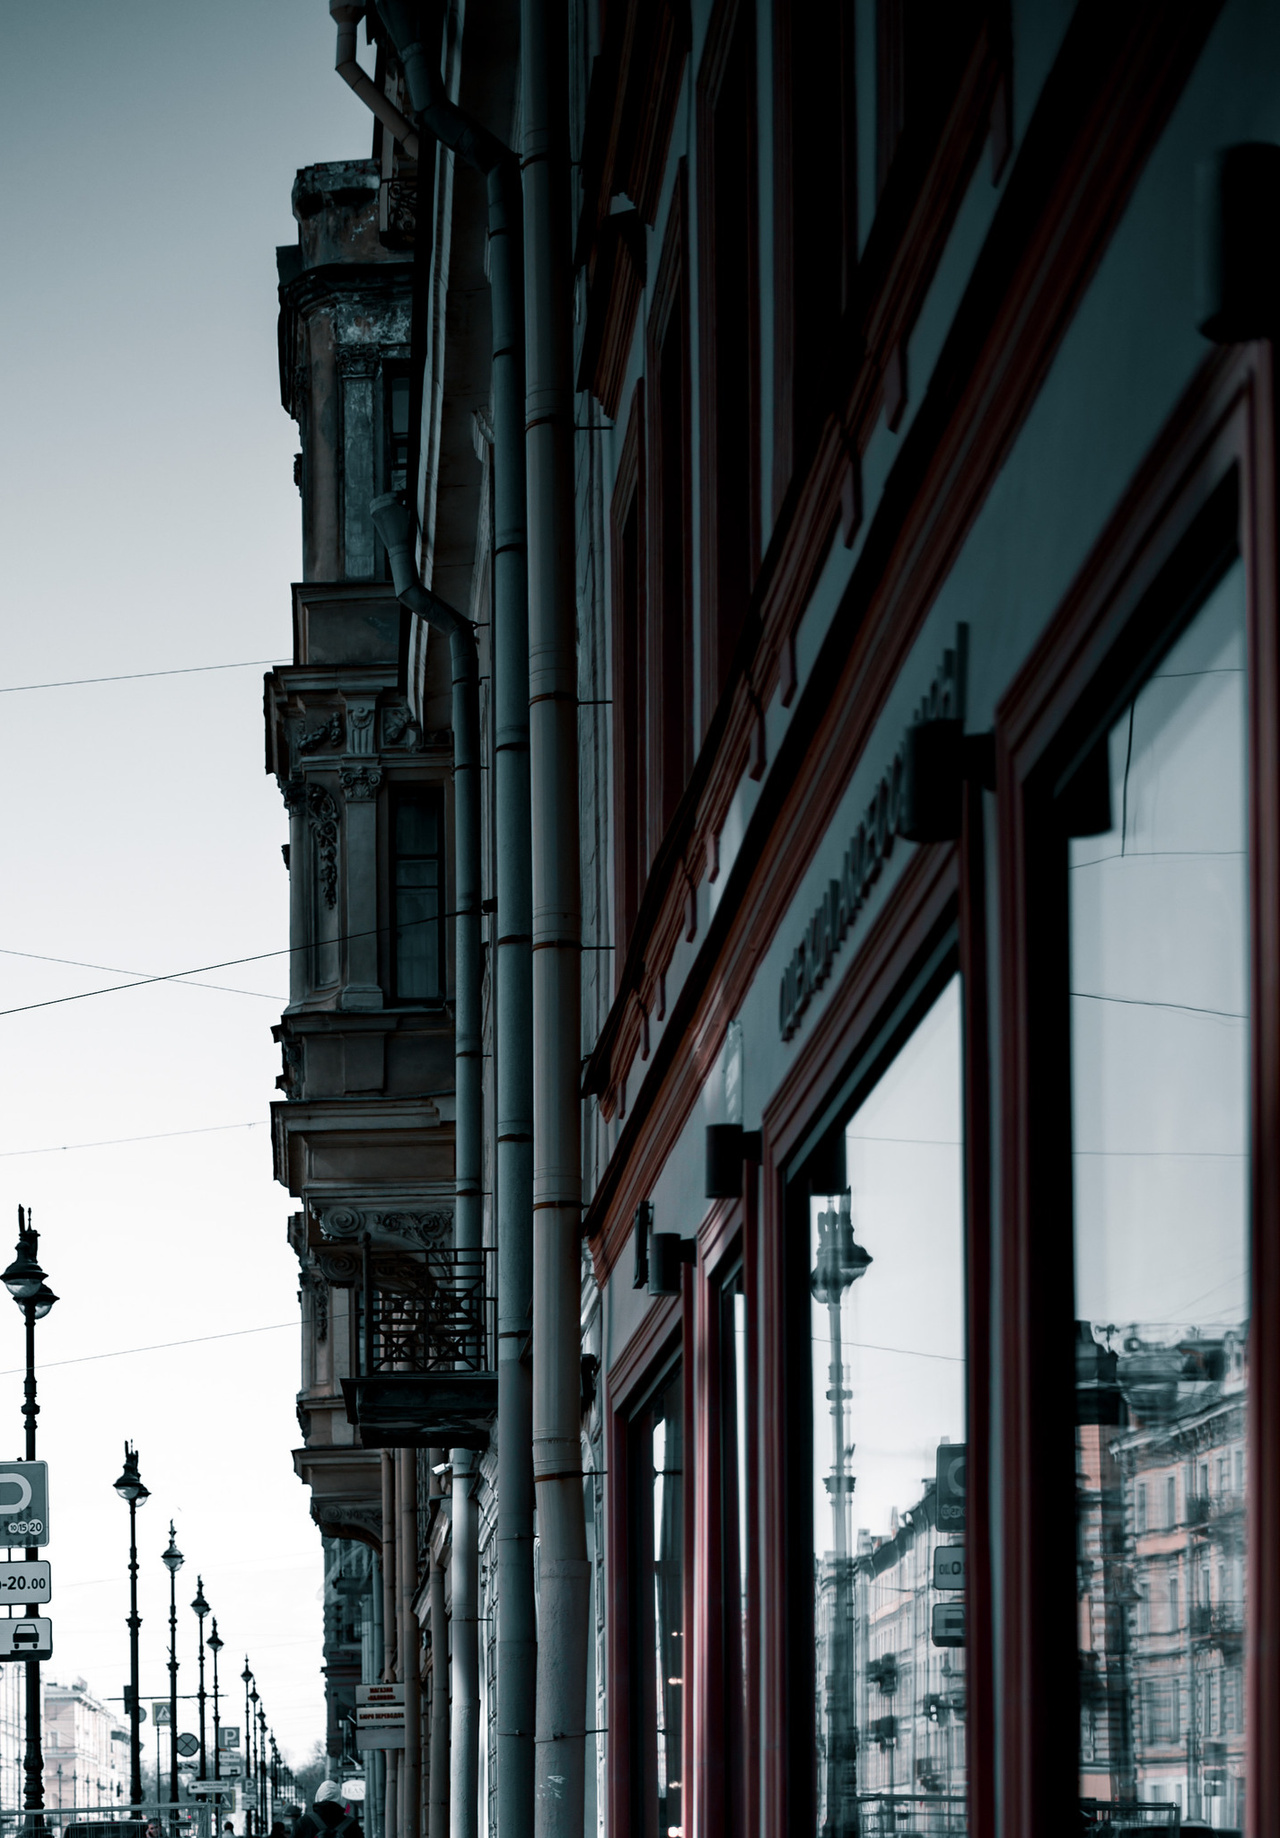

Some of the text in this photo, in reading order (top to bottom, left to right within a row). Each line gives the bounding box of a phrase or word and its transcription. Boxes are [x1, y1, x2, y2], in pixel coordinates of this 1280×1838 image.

[19, 1523, 27, 1532] 15
[29, 1521, 42, 1532] 20
[224, 1729, 237, 1746] P
